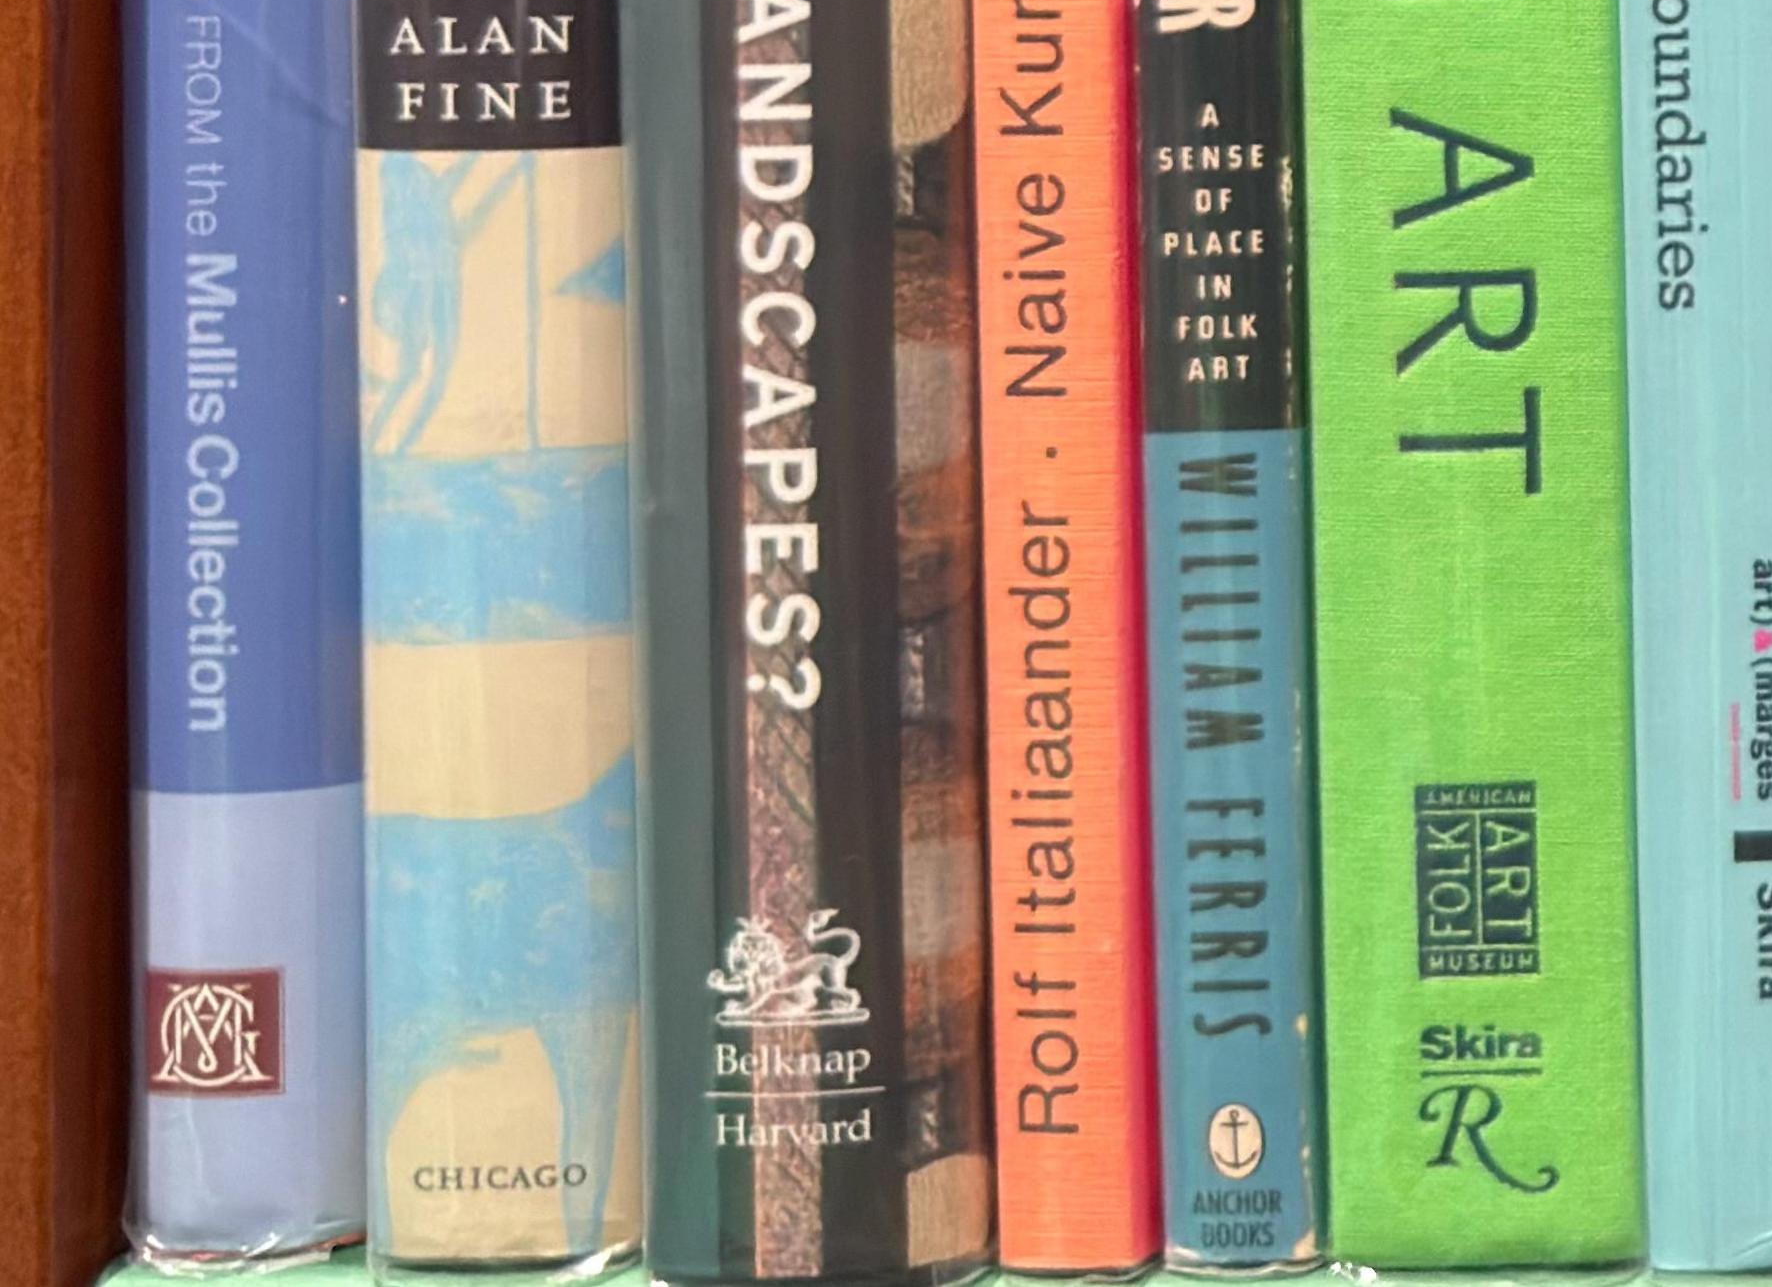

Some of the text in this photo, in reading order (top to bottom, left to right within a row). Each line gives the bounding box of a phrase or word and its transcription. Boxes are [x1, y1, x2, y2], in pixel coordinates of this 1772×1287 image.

[185, 16, 224, 144] FROM
[391, 18, 574, 54] ALAN
[395, 83, 574, 120] FINE
[185, 162, 226, 235] the
[187, 252, 238, 423] Mullis
[1005, 173, 1066, 398] Naive
[1389, 107, 1543, 495] ART
[187, 435, 238, 731] Collection
[1011, 502, 1075, 933] Italiaander
[1179, 452, 1273, 1037] WILLIAM FERRIS
[714, 1044, 872, 1081] Belknap
[1017, 974, 1080, 1134] Rolf
[413, 1164, 587, 1190] CHICAGO
[714, 1115, 874, 1144] Harvard
